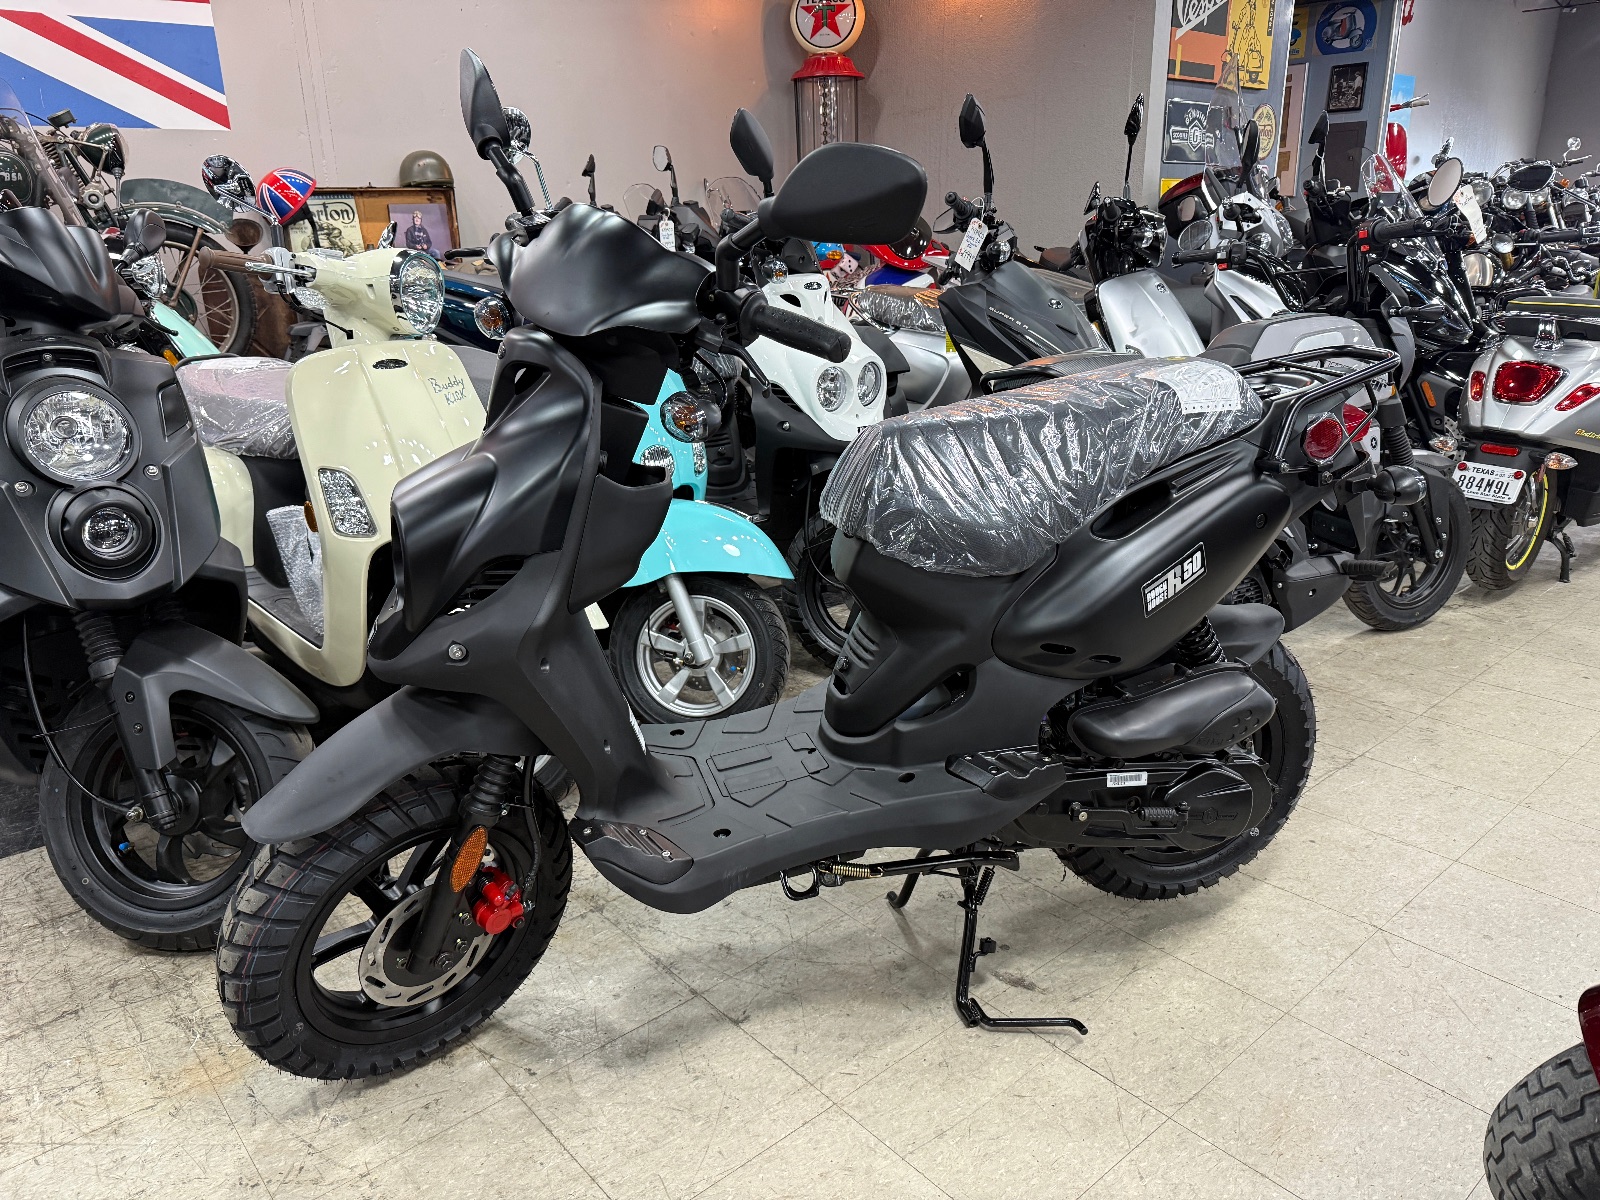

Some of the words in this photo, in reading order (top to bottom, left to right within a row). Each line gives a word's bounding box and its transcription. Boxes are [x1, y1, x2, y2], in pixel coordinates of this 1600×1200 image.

[5, 172, 23, 182] BSA
[427, 375, 465, 394] Buddy
[1472, 466, 1496, 476] TEXAS
[1457, 474, 1511, 497] 884M9L
[1146, 580, 1168, 603] ROUGH
[1147, 589, 1168, 612] HOUSE
